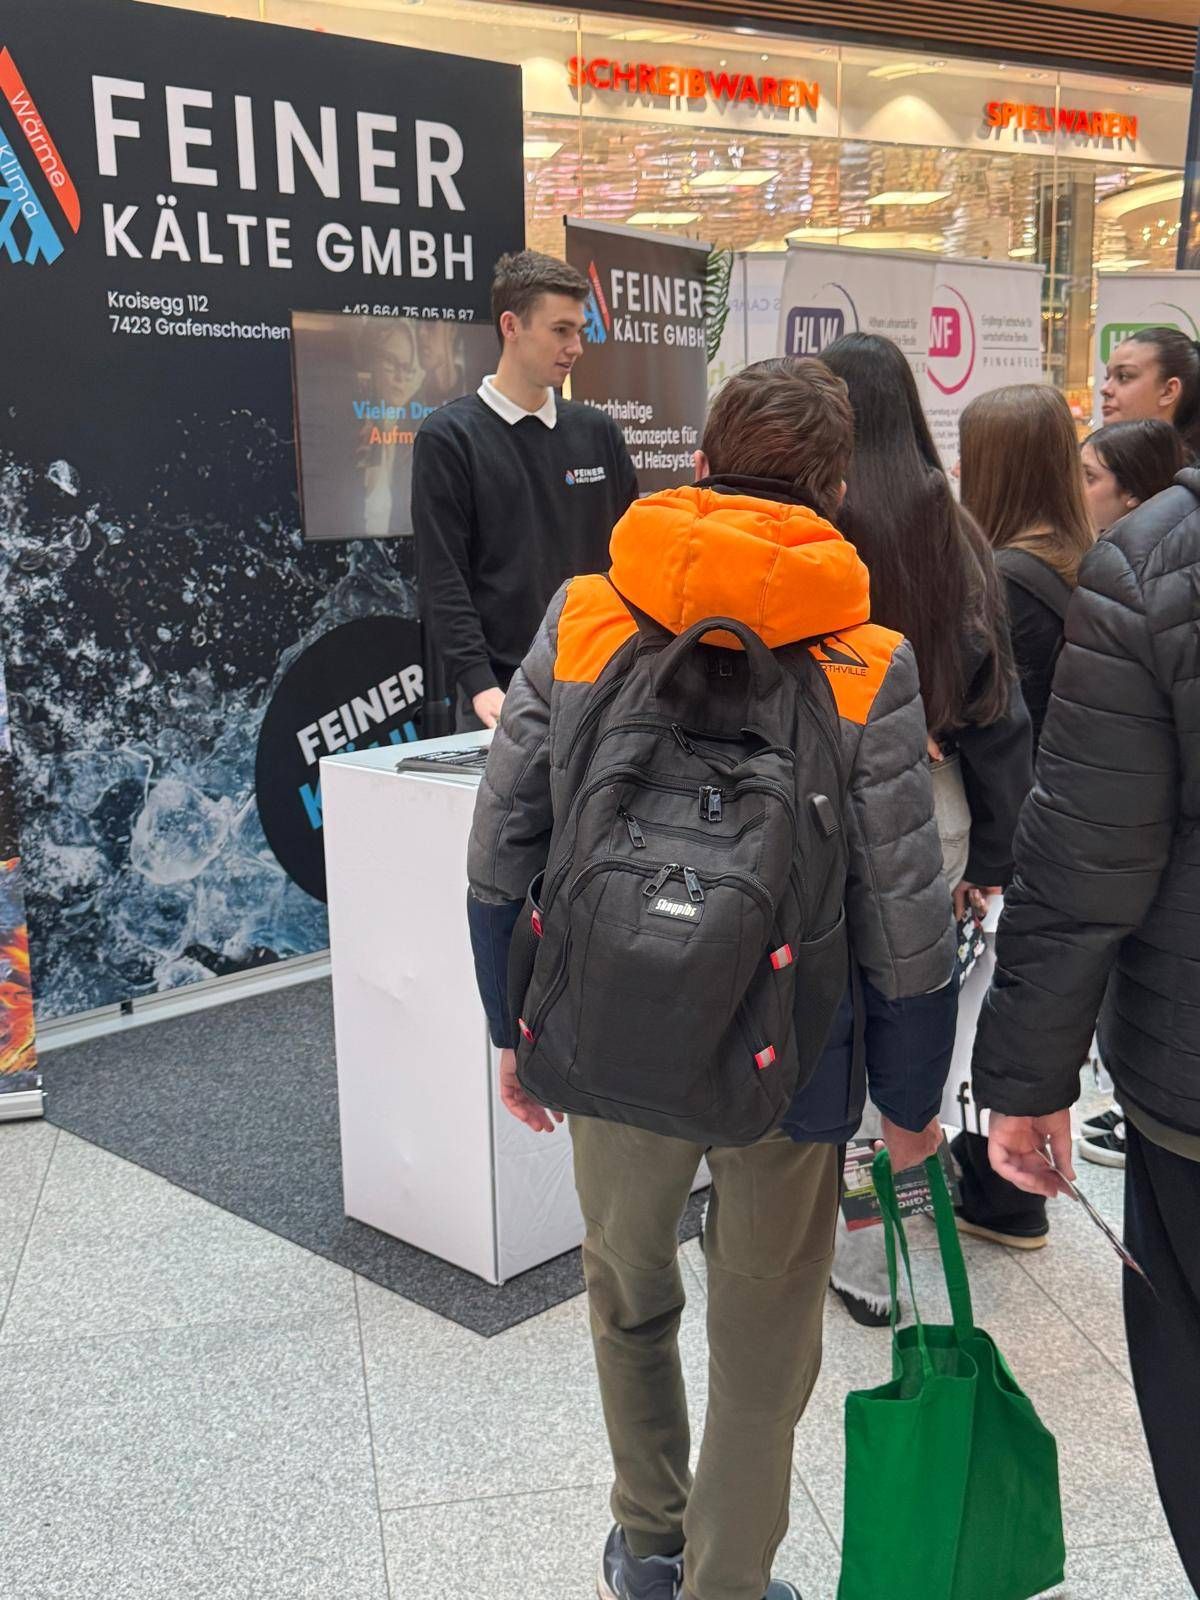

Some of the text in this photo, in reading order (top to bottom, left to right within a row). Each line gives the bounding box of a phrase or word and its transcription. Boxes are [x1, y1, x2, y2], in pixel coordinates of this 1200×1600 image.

[567, 55, 820, 110] SCHREIBWAREN
[12, 90, 66, 187] Wärme
[986, 101, 1138, 139] SPIELWAREN
[92, 74, 466, 211] FEINER
[0, 144, 39, 218] Klima
[102, 194, 474, 281] KÄLTE GMBH
[107, 291, 209, 316] Kroisegg 112
[610, 268, 703, 319] FEINER
[109, 315, 291, 340] 7423 Grafenschachen
[613, 314, 706, 348] KÄLTE GMBH
[792, 316, 839, 354] HLW
[352, 400, 406, 420] Vielen
[369, 426, 417, 445] Aufm
[681, 425, 698, 444] für
[645, 451, 696, 473] Heizsyste
[296, 663, 424, 767] FEINER
